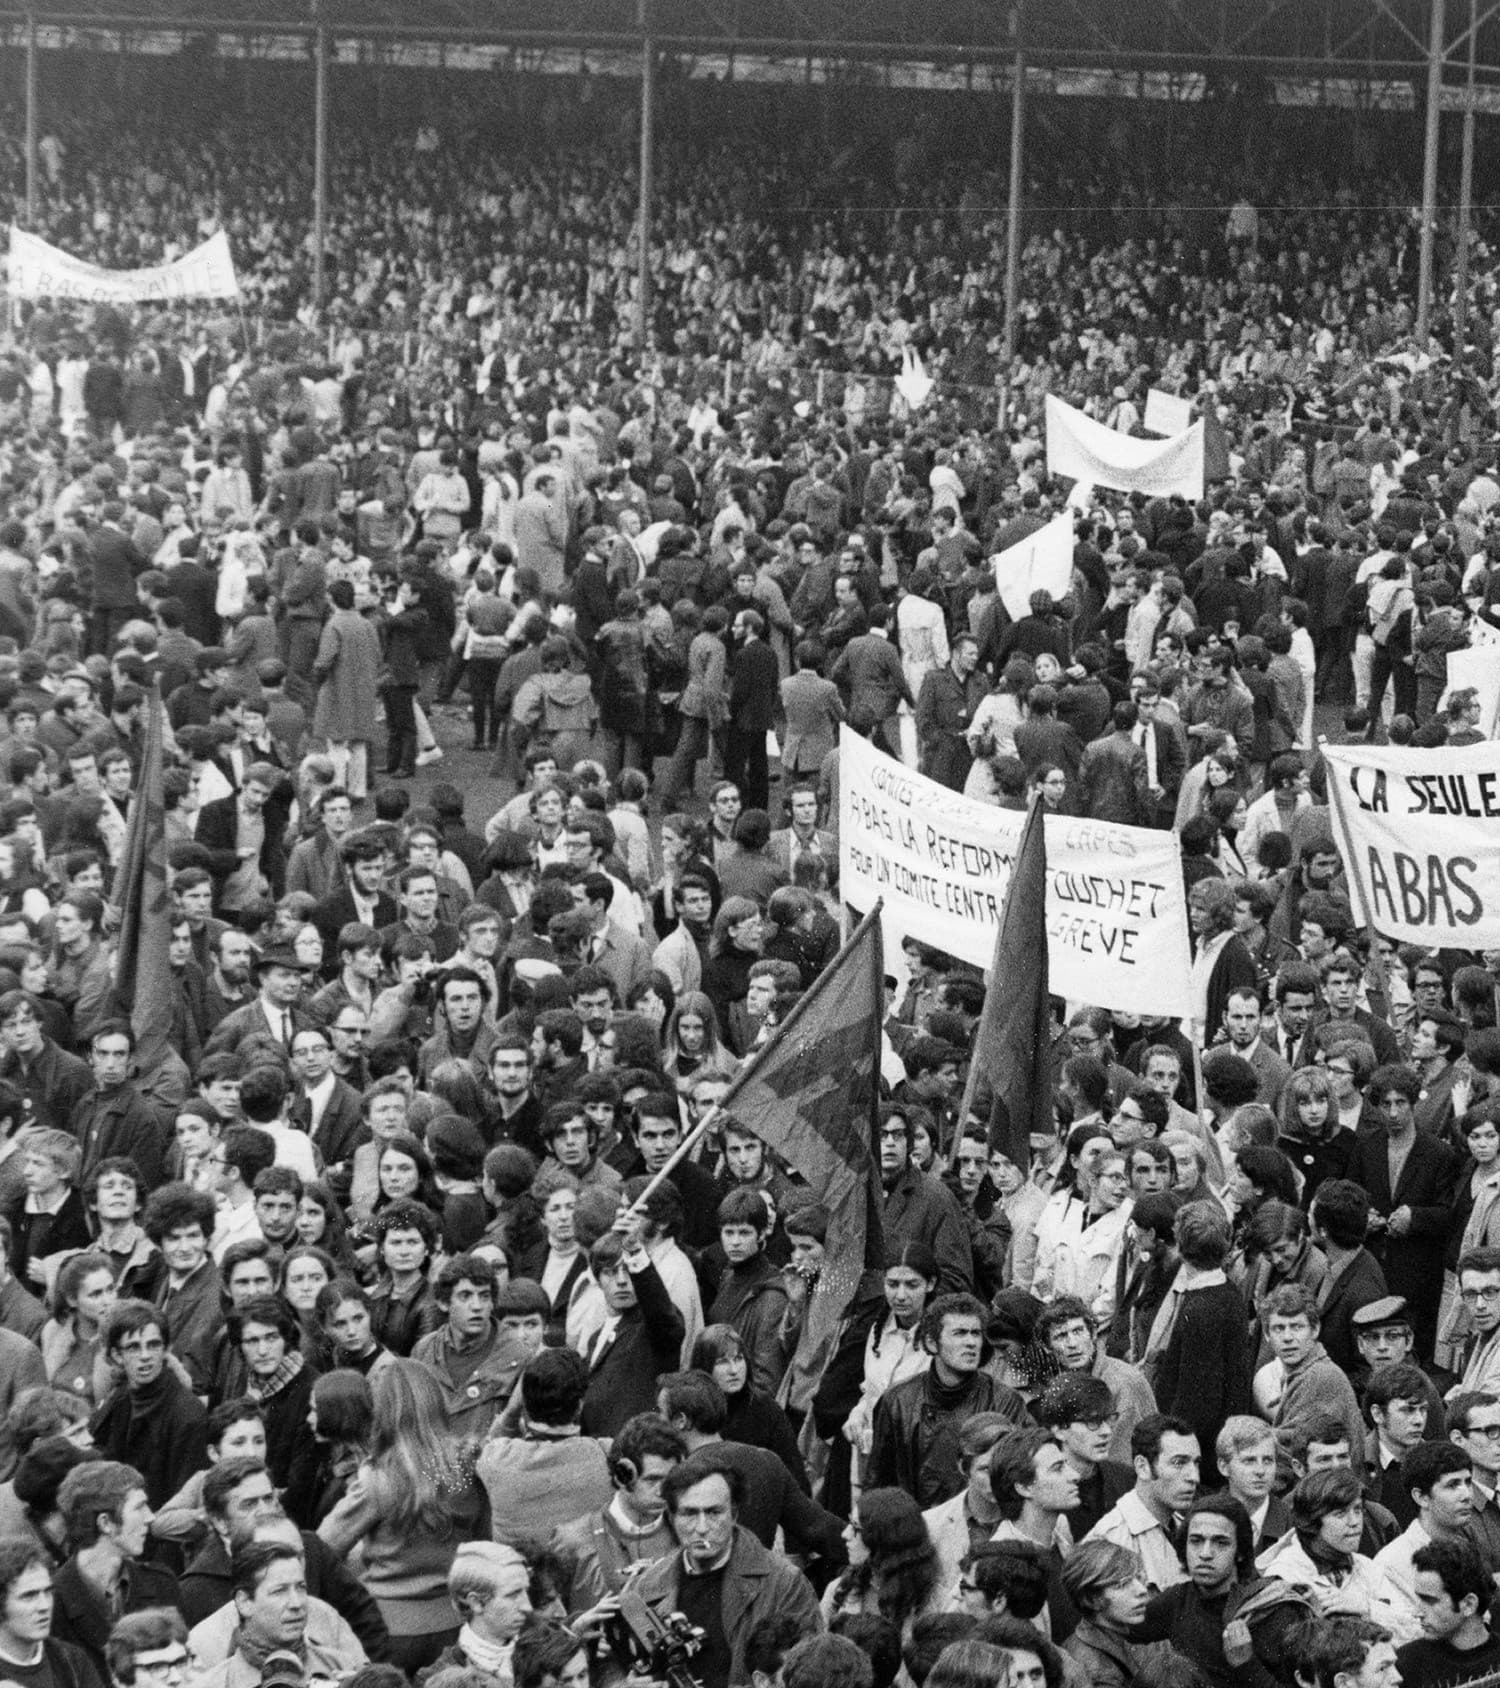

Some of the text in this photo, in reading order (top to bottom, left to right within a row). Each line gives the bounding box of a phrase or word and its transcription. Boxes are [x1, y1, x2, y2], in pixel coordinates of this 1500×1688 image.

[1350, 766, 1388, 813] LA
[895, 862, 941, 909] COMITE
[946, 882, 1004, 926] CENTR
[1050, 912, 1138, 964] GREVE
[899, 816, 921, 856] LA
[927, 824, 1016, 878] REFORM
[1046, 867, 1166, 919] OUCHET
